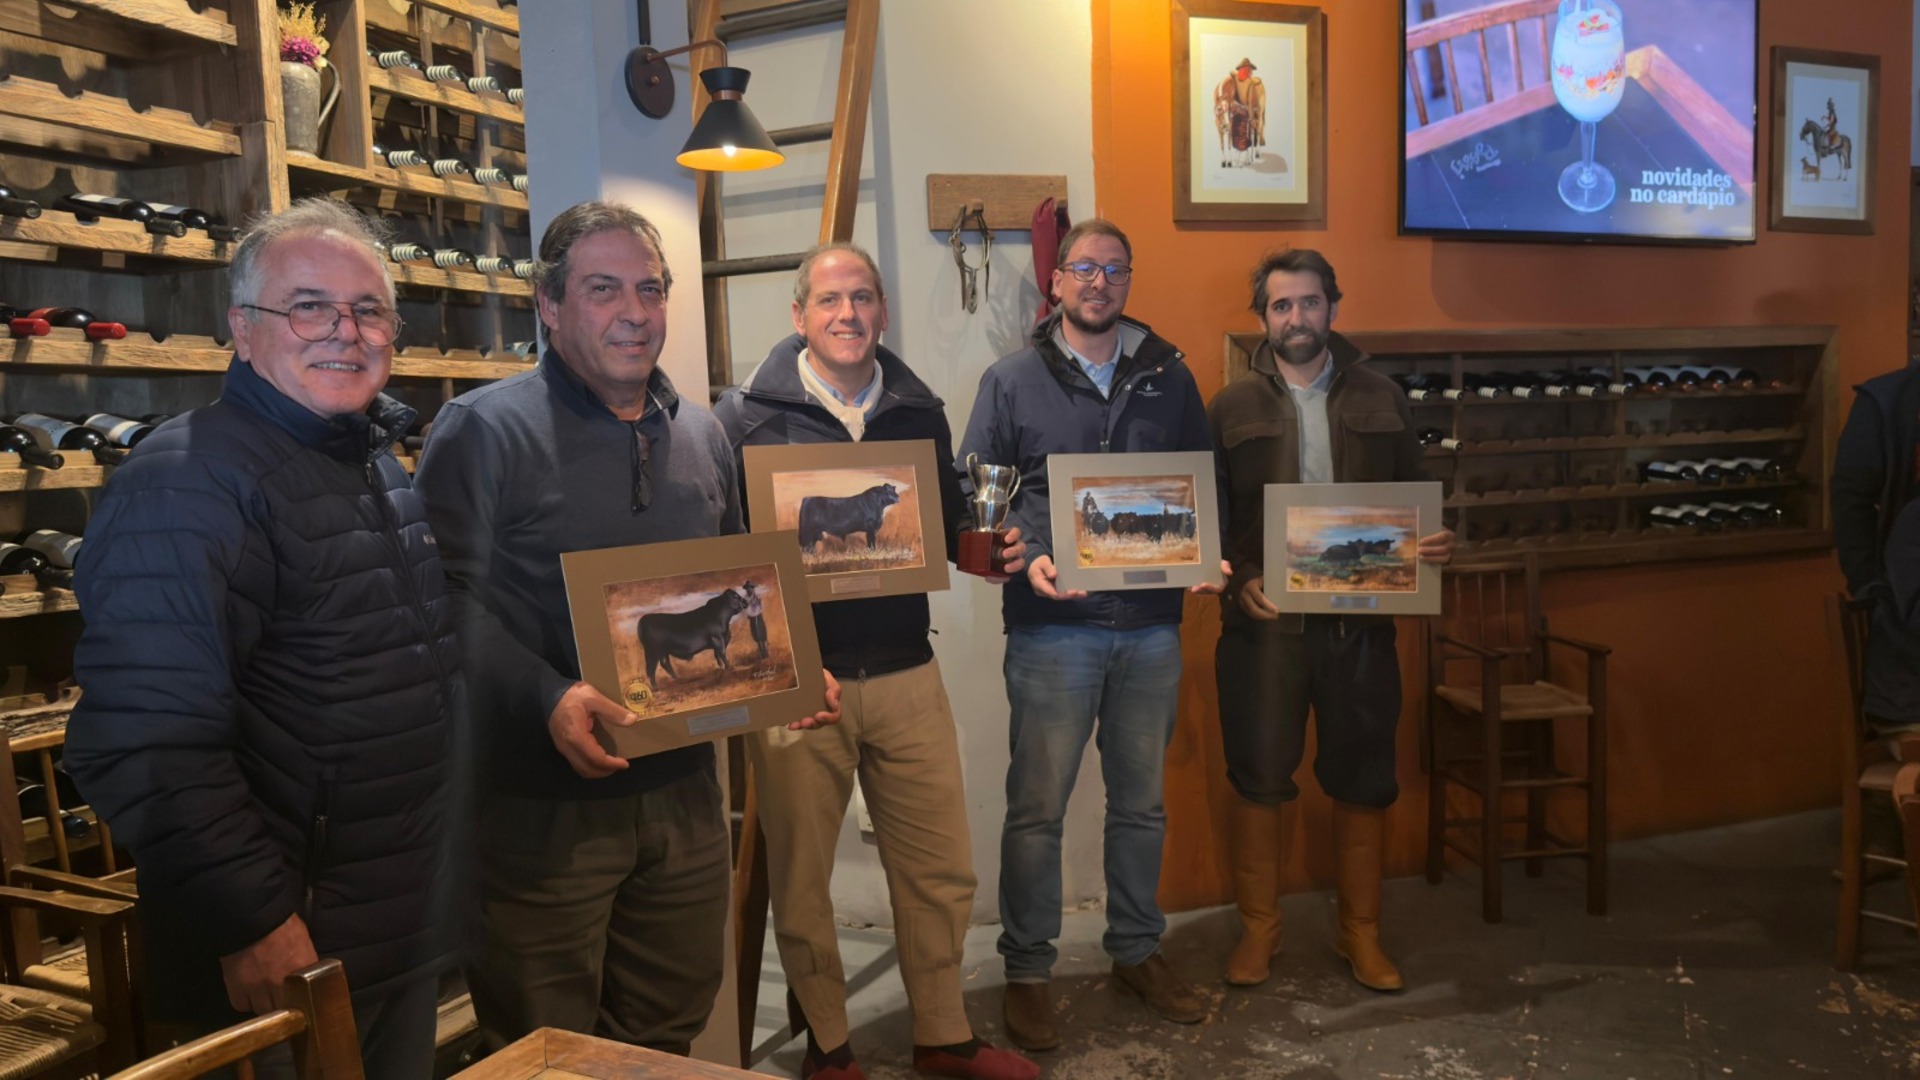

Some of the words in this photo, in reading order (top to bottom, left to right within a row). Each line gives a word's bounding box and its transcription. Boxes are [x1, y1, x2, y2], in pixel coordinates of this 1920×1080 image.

[1641, 167, 1732, 187] novidades
[1630, 188, 1653, 202] no
[1657, 187, 1735, 209] cardápio
